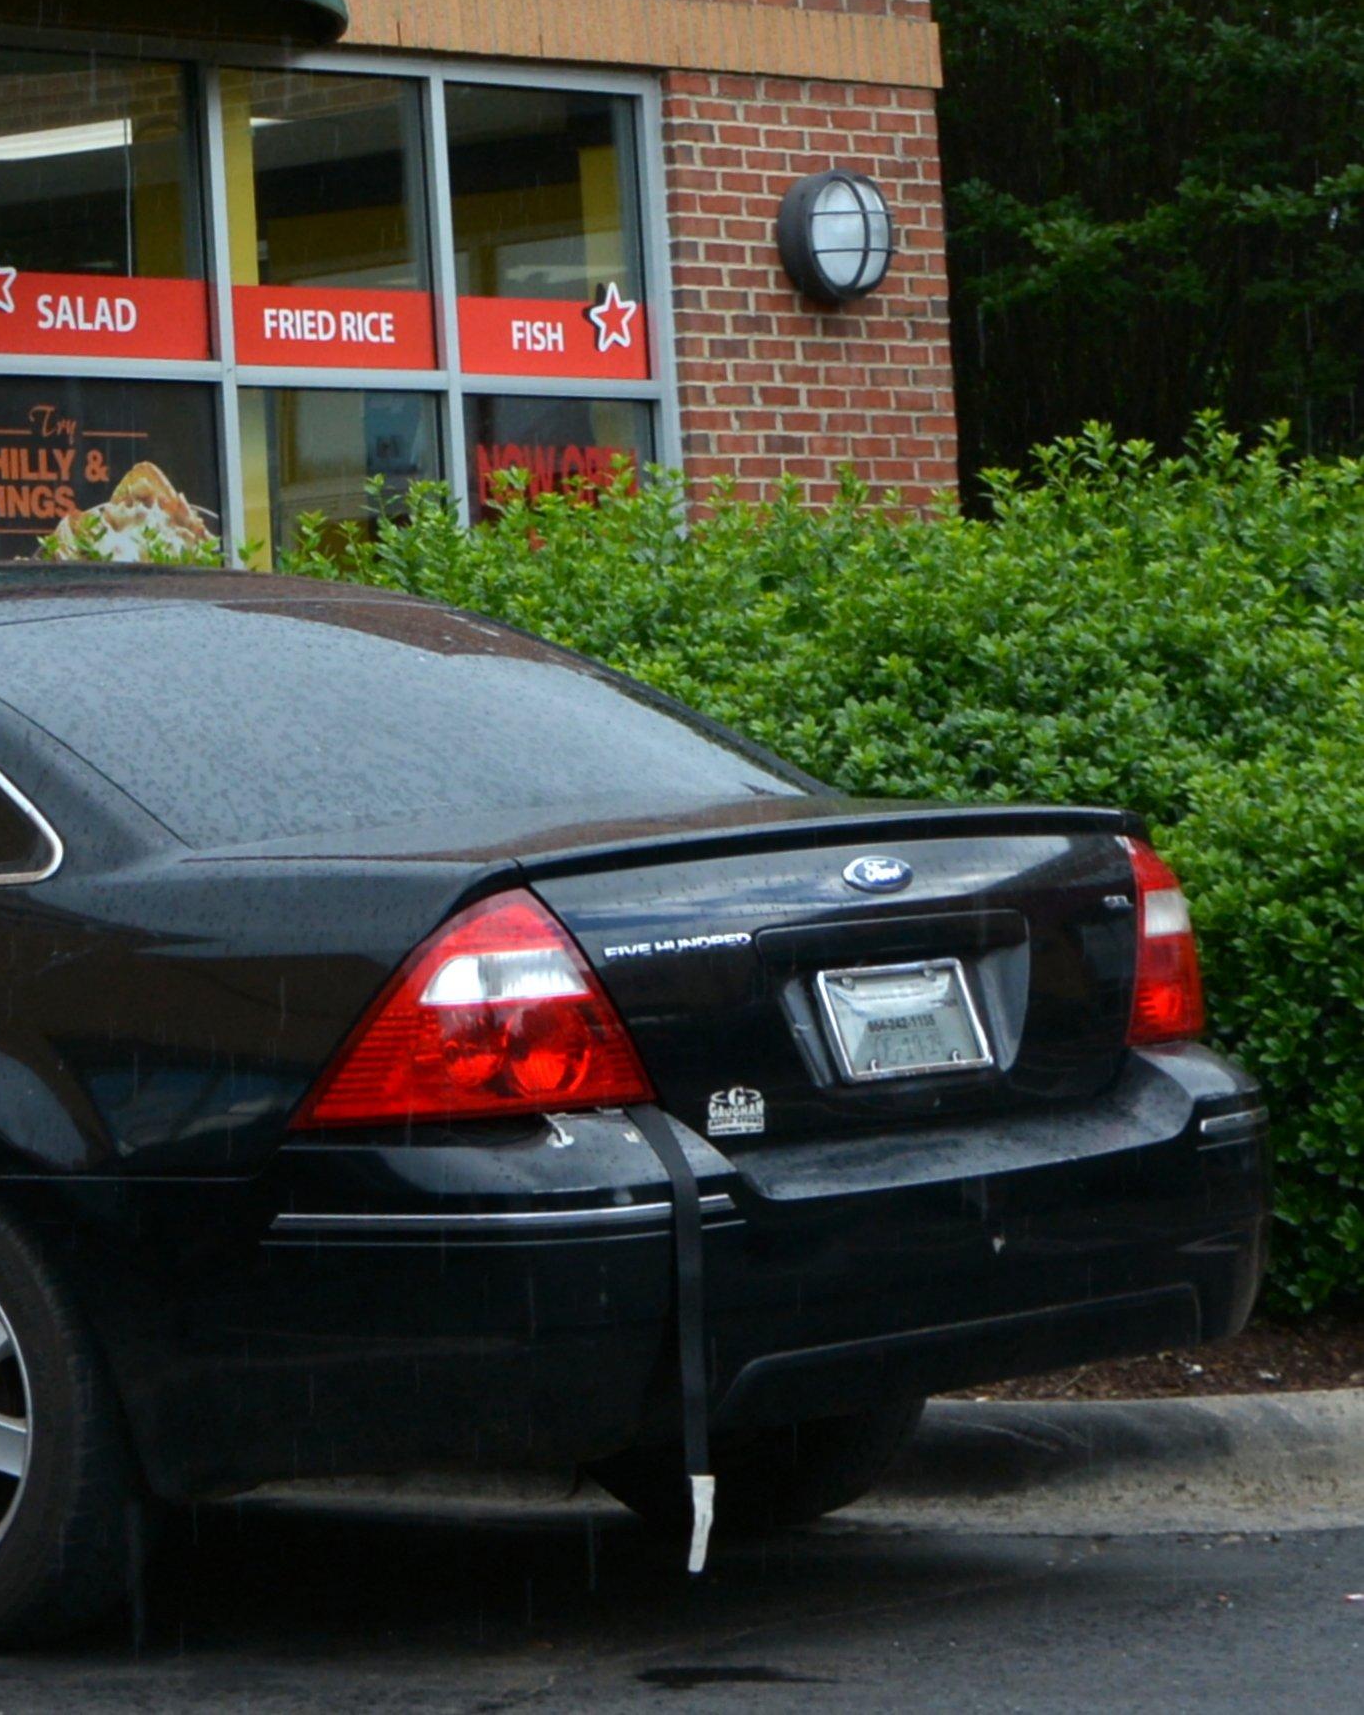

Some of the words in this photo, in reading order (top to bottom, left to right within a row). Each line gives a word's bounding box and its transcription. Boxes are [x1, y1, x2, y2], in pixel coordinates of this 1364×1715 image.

[36, 294, 138, 333] SALAD
[263, 307, 337, 342] FRIED
[341, 310, 396, 344] RICE
[511, 320, 565, 353] FISH
[28, 404, 78, 445] Try
[84, 448, 111, 483] &
[603, 942, 653, 961] FIVE
